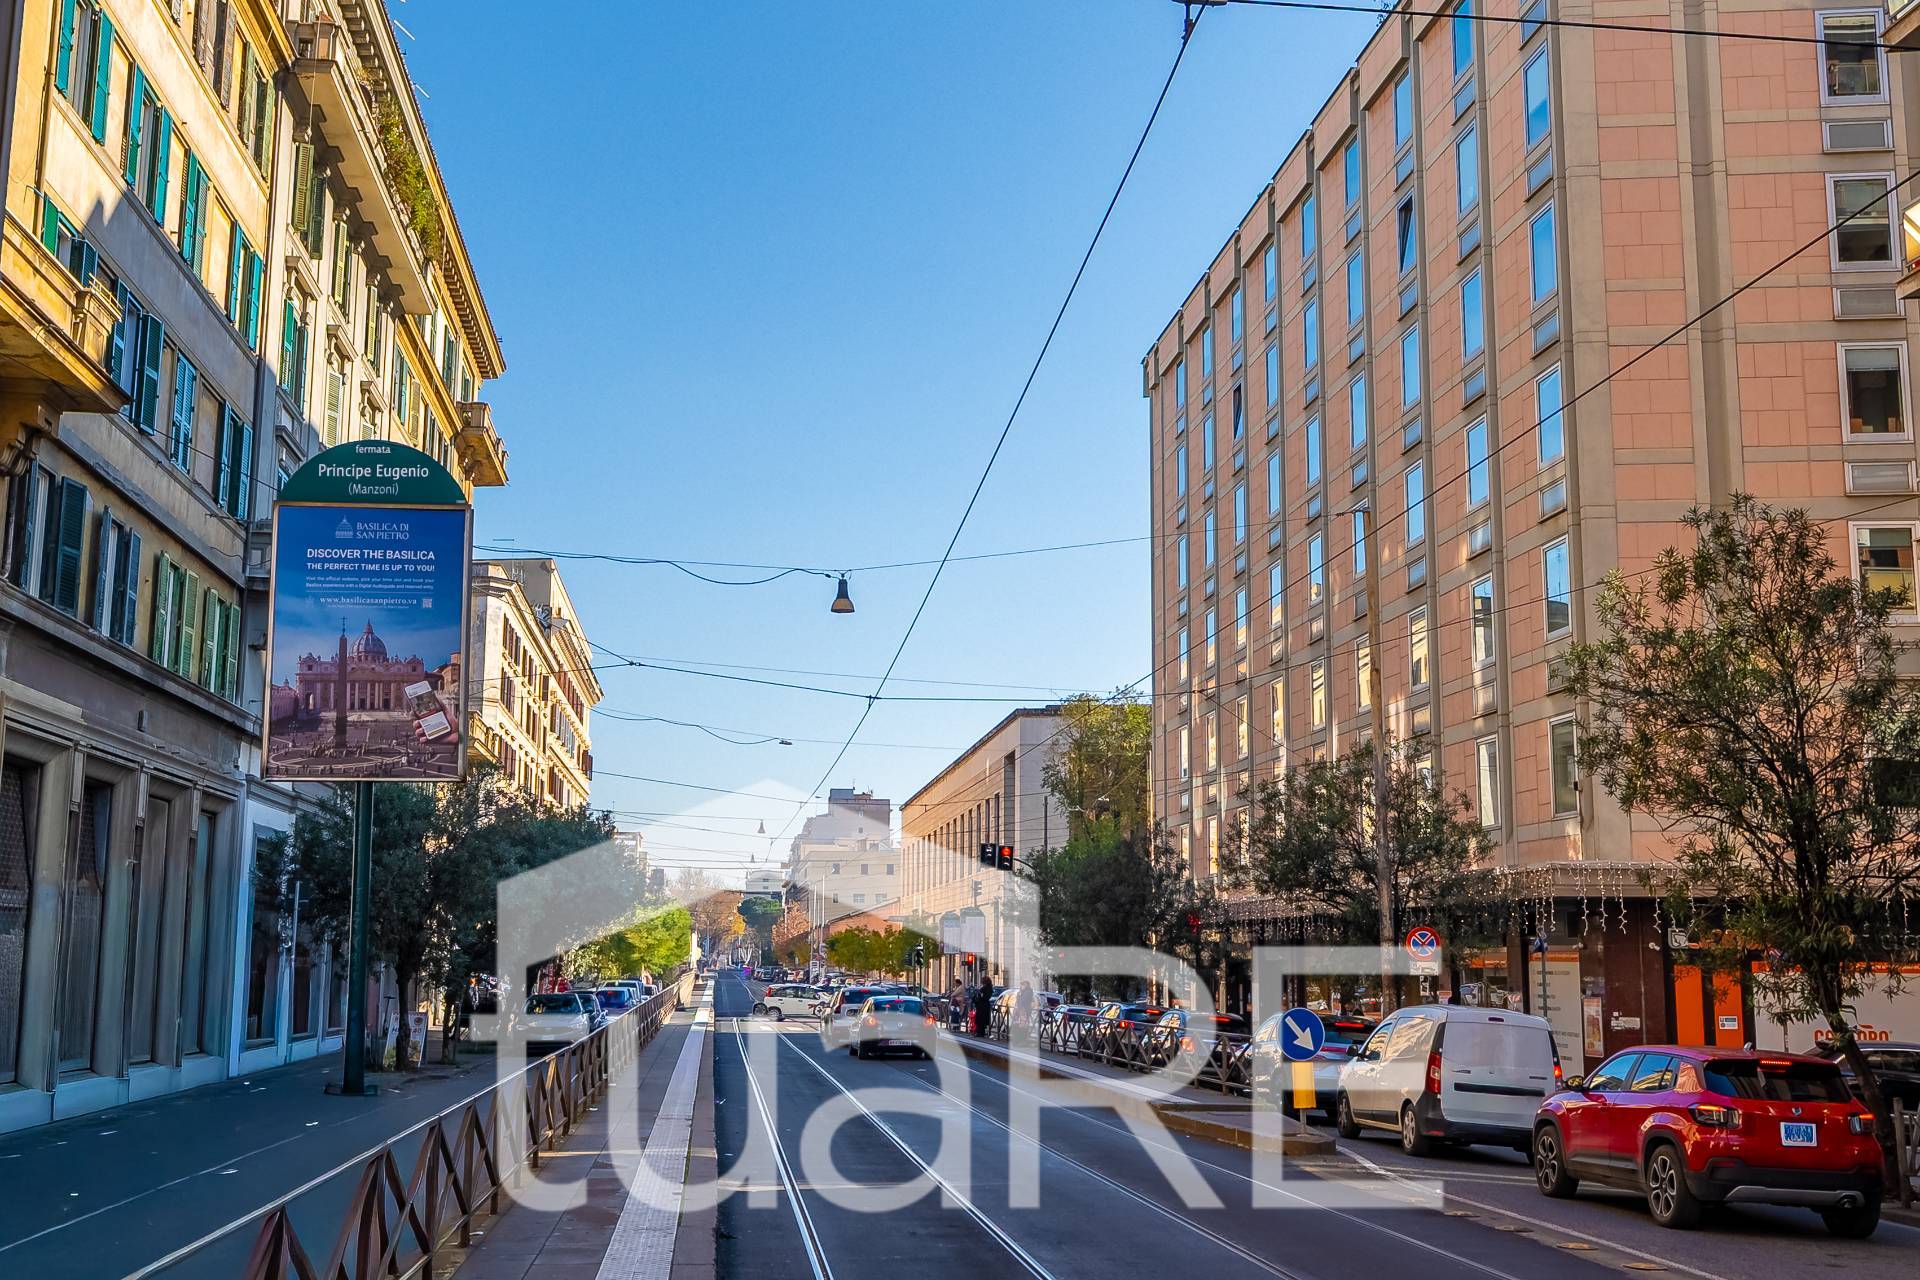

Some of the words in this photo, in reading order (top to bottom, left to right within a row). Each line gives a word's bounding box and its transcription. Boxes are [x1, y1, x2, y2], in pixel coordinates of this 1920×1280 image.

[355, 444, 391, 454] fermata
[318, 463, 372, 480] Principe
[376, 464, 429, 480] Eugenio
[348, 482, 399, 496] (Manzoni)
[356, 521, 398, 531] BASILICA
[400, 523, 409, 531] DI
[356, 531, 376, 539] SAN
[376, 531, 410, 540] PIETRO
[307, 548, 361, 559] DISCOVER
[362, 549, 384, 559] THE
[386, 550, 435, 560] BASILICA
[306, 562, 322, 570] THE
[324, 563, 359, 571] PERFECT
[361, 563, 381, 571] TIME
[417, 564, 435, 572] YOU!
[319, 595, 417, 605] www.basilicasanpietro.va
